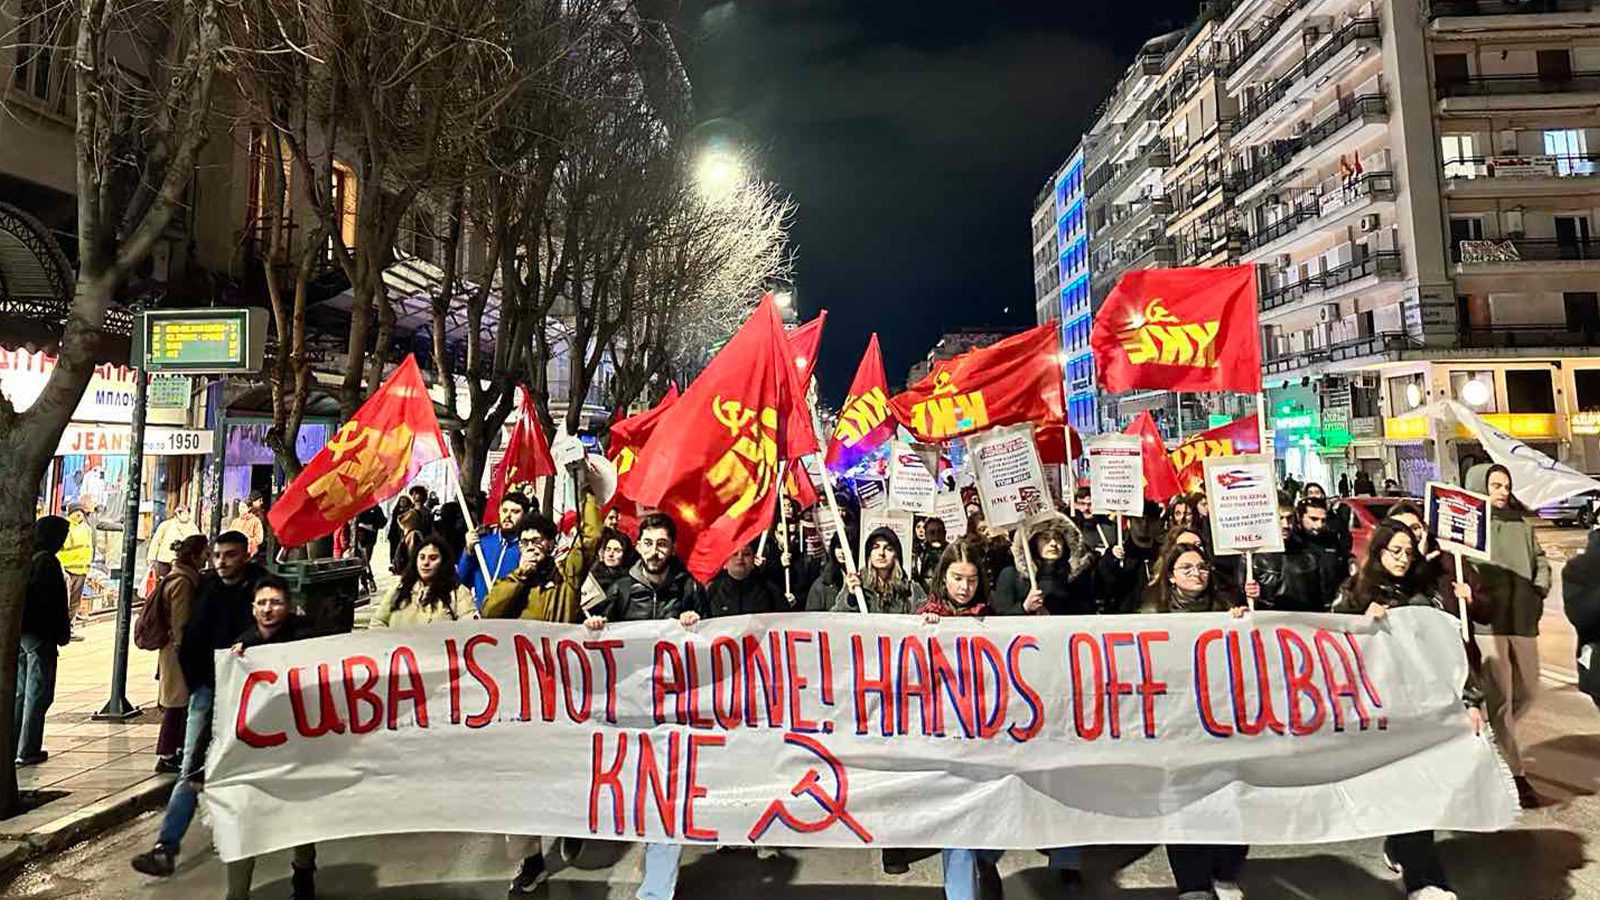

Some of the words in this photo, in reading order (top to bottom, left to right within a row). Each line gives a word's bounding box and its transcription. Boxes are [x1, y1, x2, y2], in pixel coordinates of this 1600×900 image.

[168, 433, 200, 450] 1950
[235, 646, 429, 749] CUBA
[445, 634, 500, 729] IS
[514, 634, 624, 724] NOT
[653, 630, 836, 734] ALONE!
[851, 631, 1045, 743] HANDS
[1068, 630, 1169, 742] OFF
[1193, 627, 1388, 739] CUBA!
[588, 730, 727, 842] KNE
